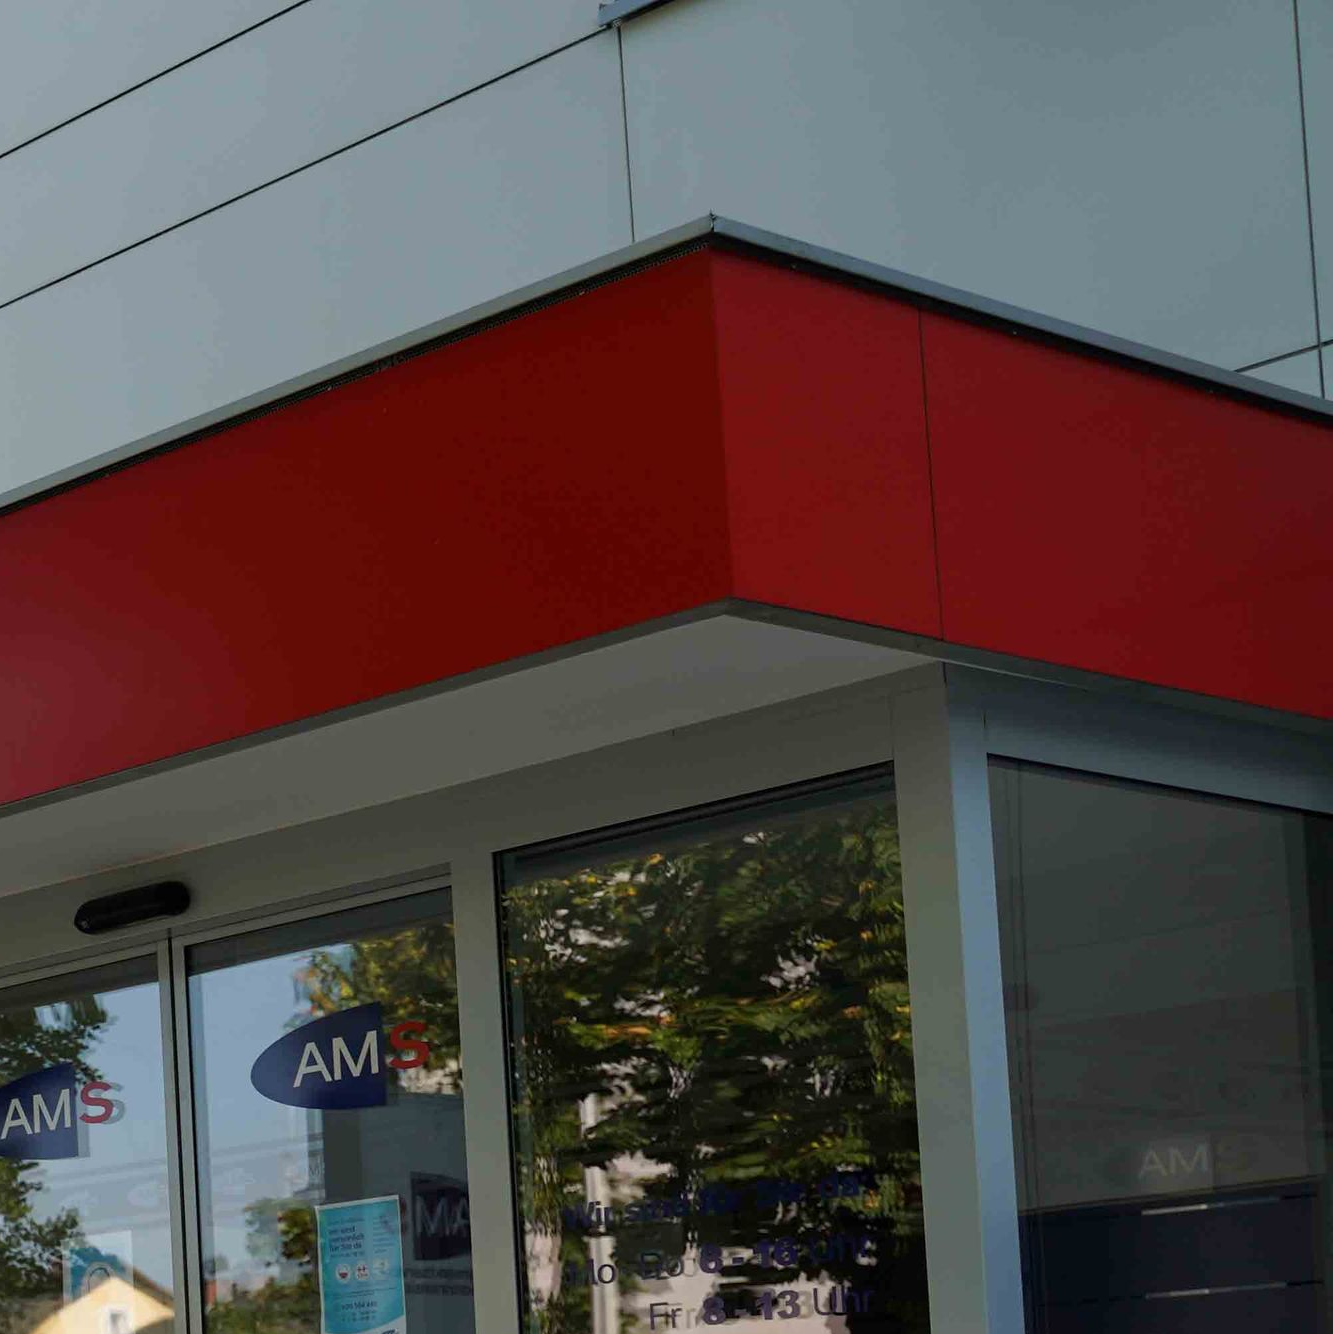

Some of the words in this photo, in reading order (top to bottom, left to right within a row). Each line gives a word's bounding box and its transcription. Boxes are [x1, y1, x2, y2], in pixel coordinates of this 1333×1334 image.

[293, 1020, 430, 1087] AMS
[1, 1081, 113, 1139] AMS
[699, 1243, 724, 1273] 8
[754, 1237, 798, 1267] 16
[702, 1295, 726, 1325] 8
[757, 1289, 801, 1320] 13
